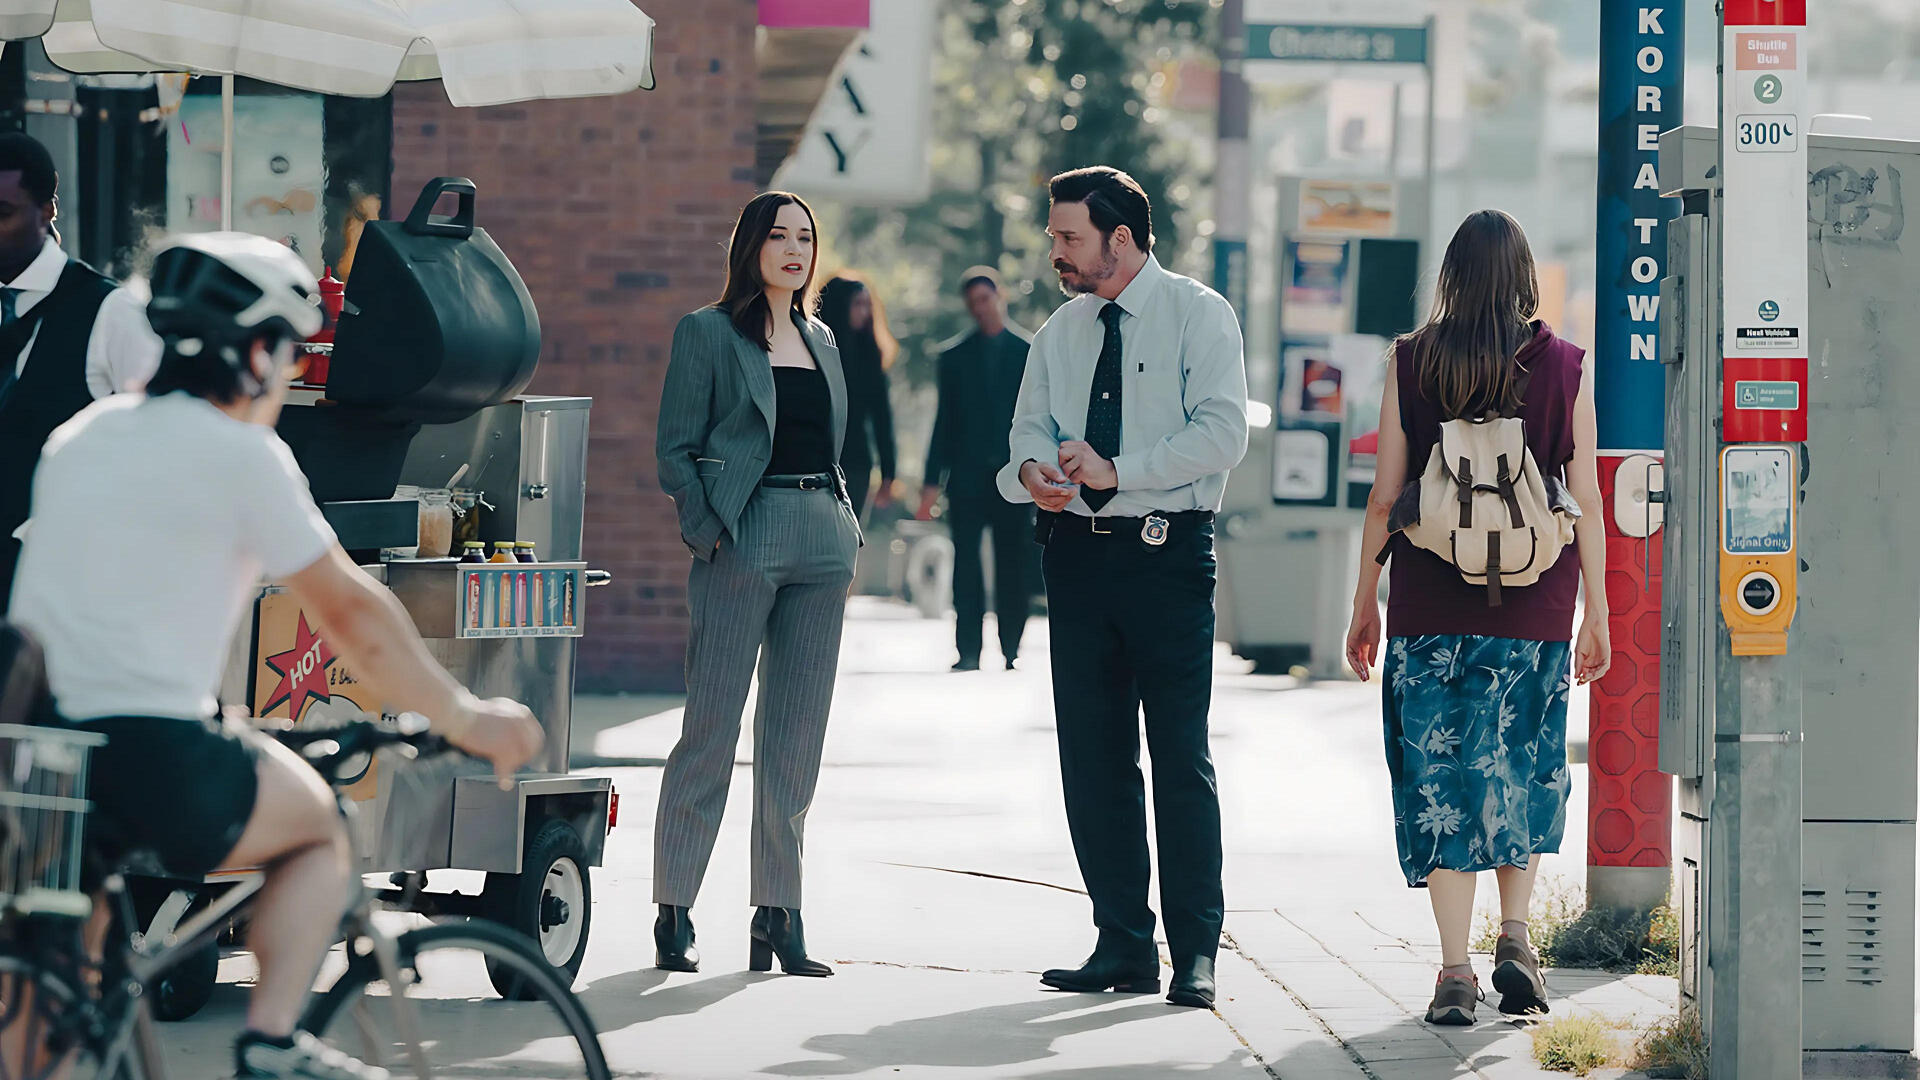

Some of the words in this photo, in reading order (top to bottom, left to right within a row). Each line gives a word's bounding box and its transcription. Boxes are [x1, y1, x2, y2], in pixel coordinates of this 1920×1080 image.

[1762, 80, 1775, 98] 2
[1740, 122, 1781, 145] 300
[289, 638, 322, 690] HOT
